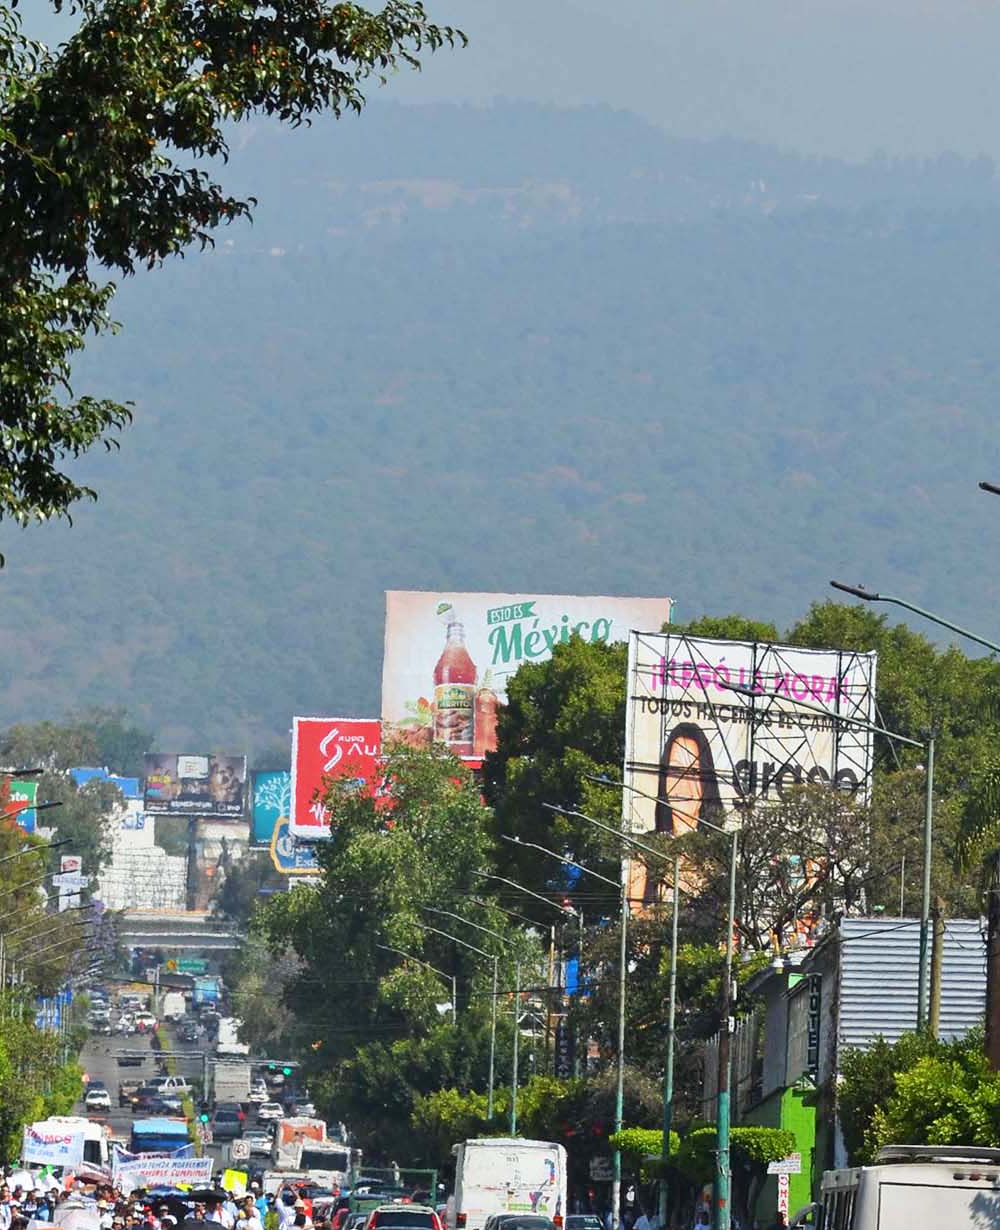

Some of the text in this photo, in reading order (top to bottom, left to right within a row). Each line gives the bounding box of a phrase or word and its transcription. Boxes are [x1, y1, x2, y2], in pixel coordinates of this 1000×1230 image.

[491, 606, 524, 623] ESTO ES
[488, 615, 613, 664] México
[641, 695, 692, 719] TODOS
